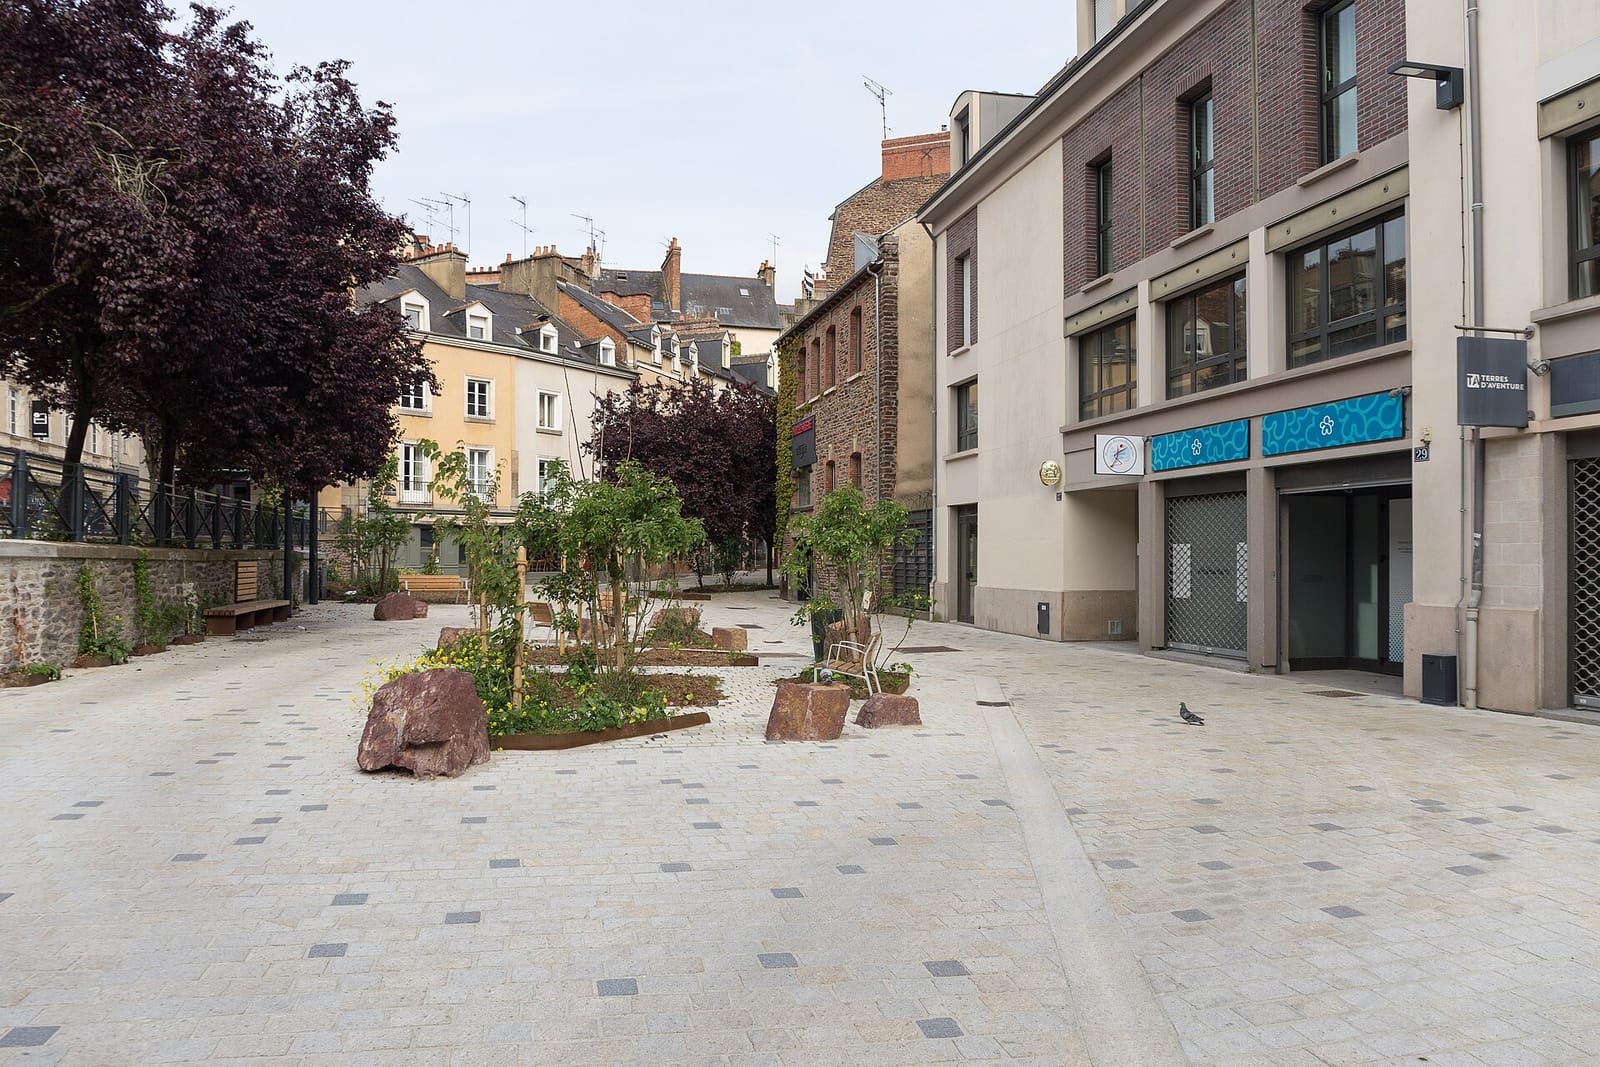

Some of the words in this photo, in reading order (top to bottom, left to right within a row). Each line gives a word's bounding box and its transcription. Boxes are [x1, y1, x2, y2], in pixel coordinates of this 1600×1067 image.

[1481, 374, 1509, 383] TERRES
[1480, 382, 1525, 391] D'AVENTURE
[1415, 448, 1428, 459] 29
